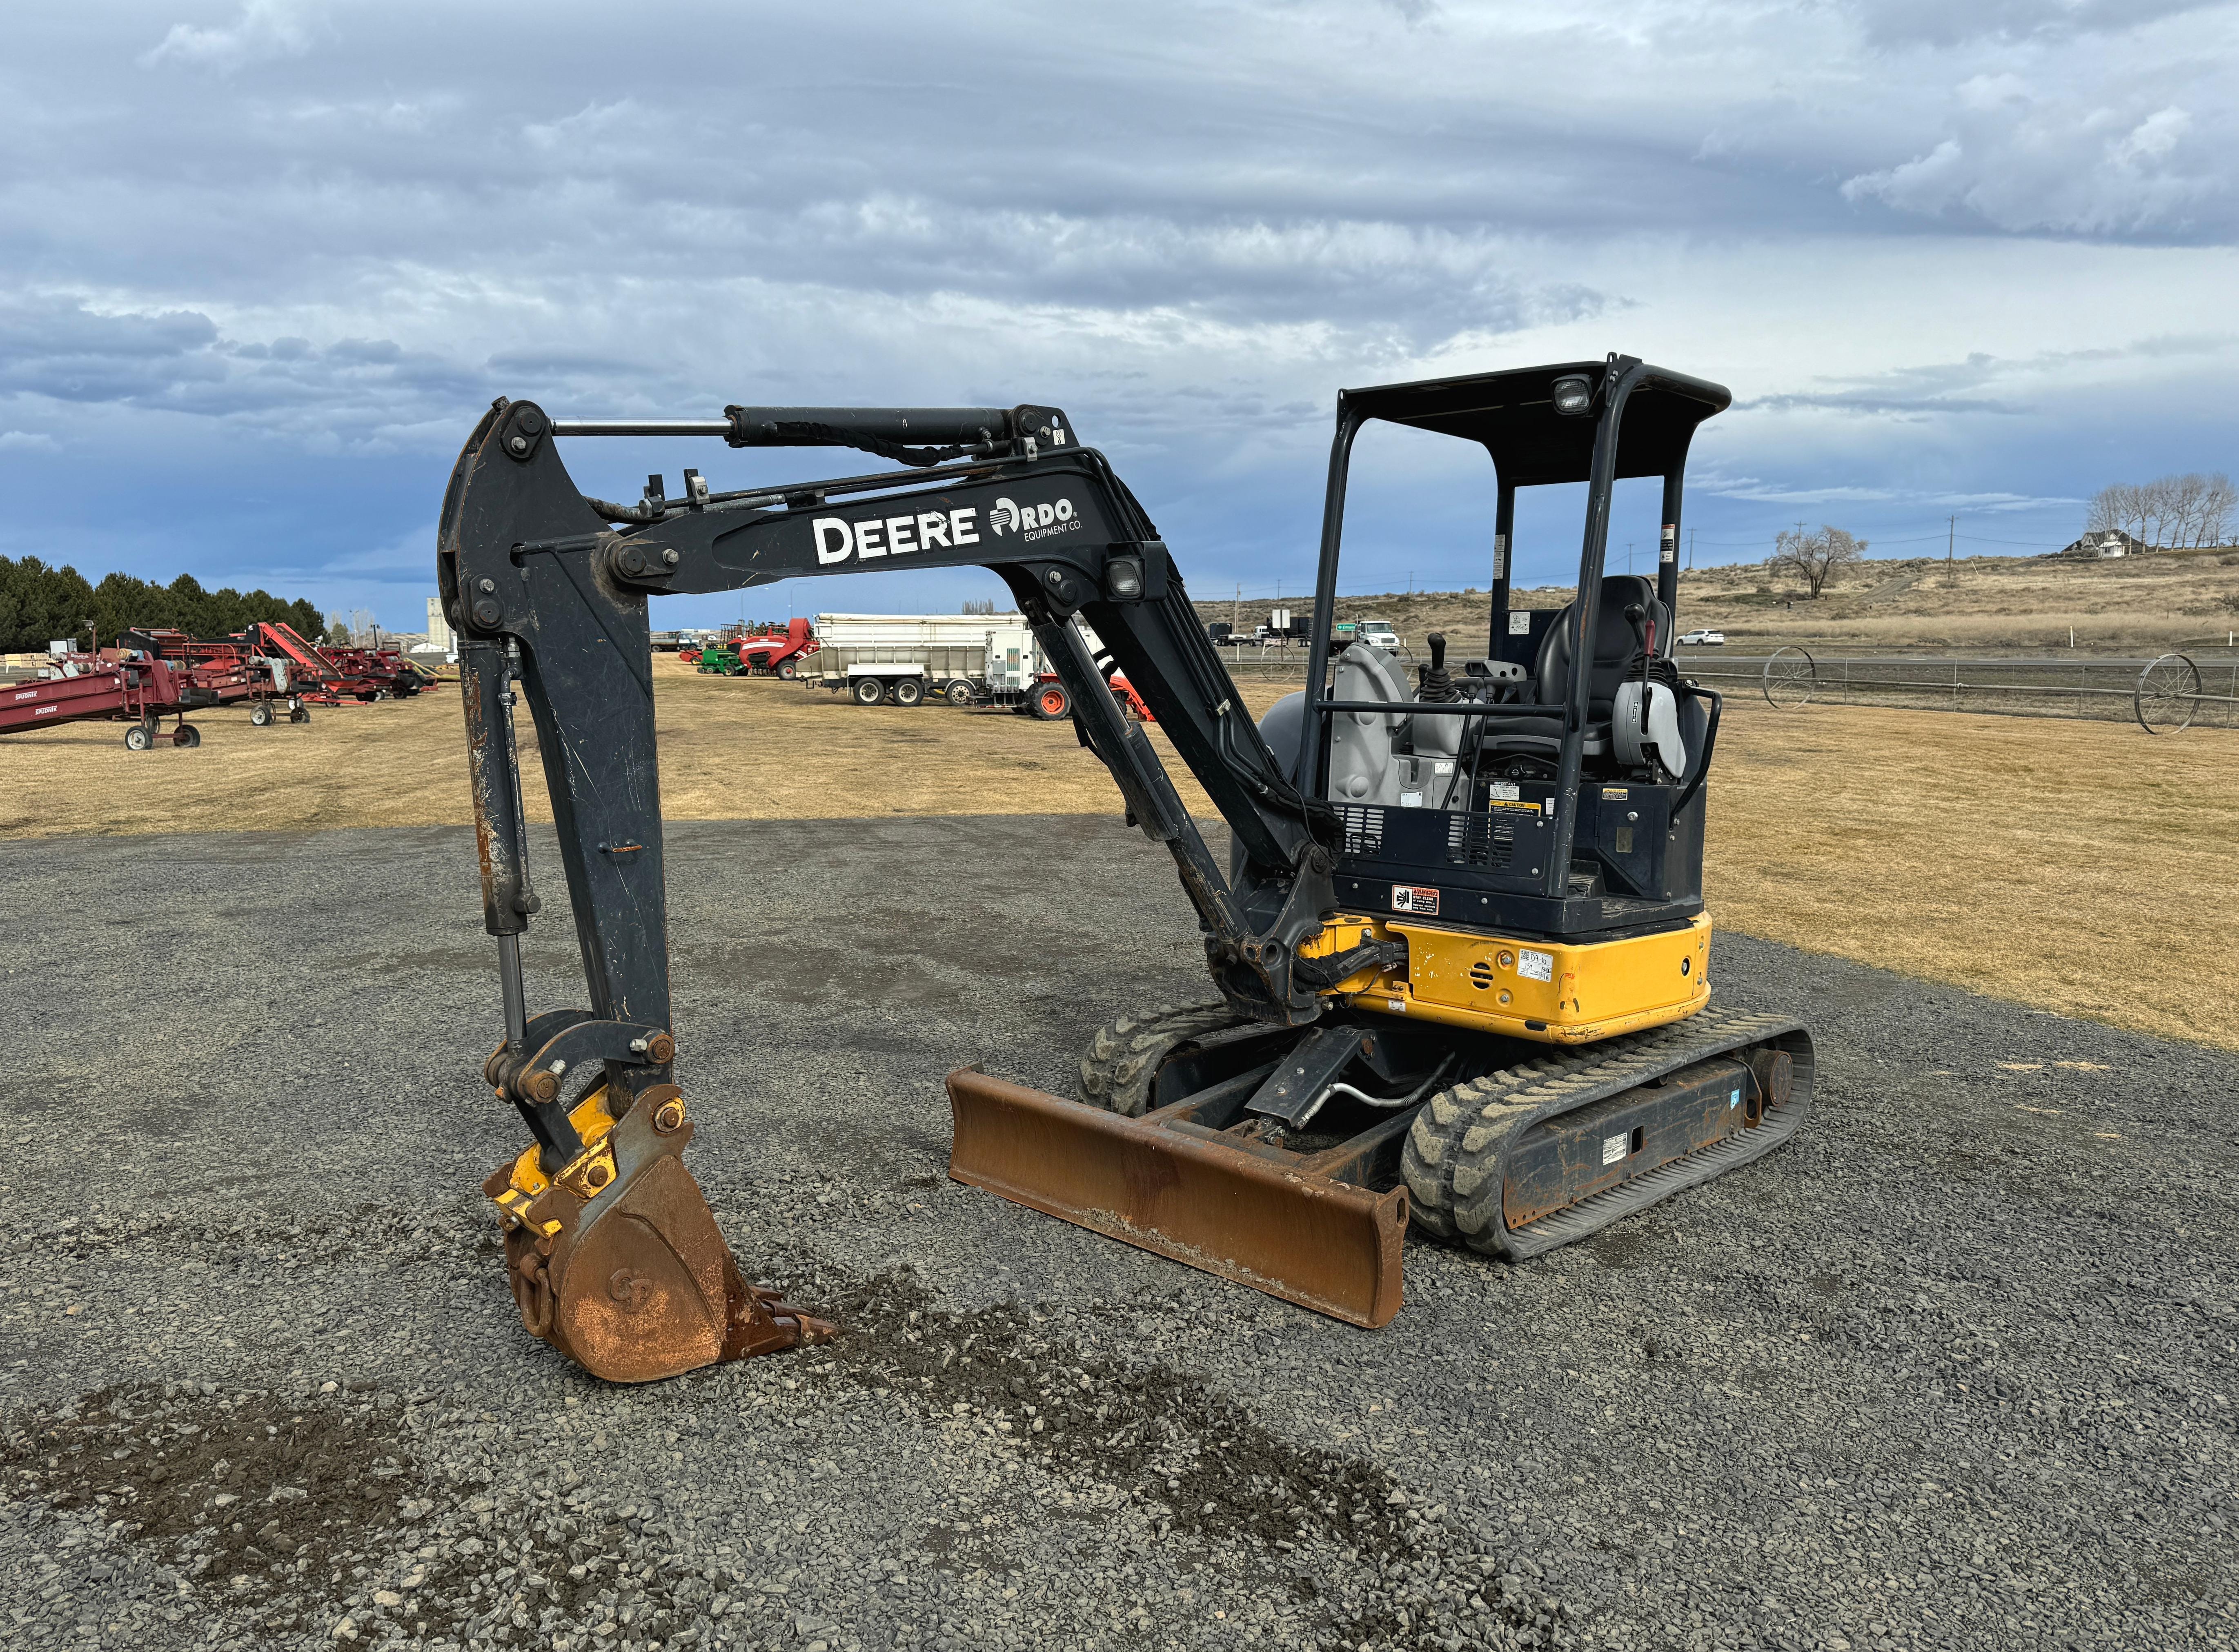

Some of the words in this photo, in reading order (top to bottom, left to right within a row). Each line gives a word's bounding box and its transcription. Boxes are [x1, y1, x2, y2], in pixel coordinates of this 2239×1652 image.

[812, 507, 979, 565] DEERE
[1024, 523, 1067, 542] EQUIPMENT
[1069, 520, 1083, 530] CO.
[15, 691, 37, 700] SPUDNIK
[35, 705, 58, 715] SPUDNIK
